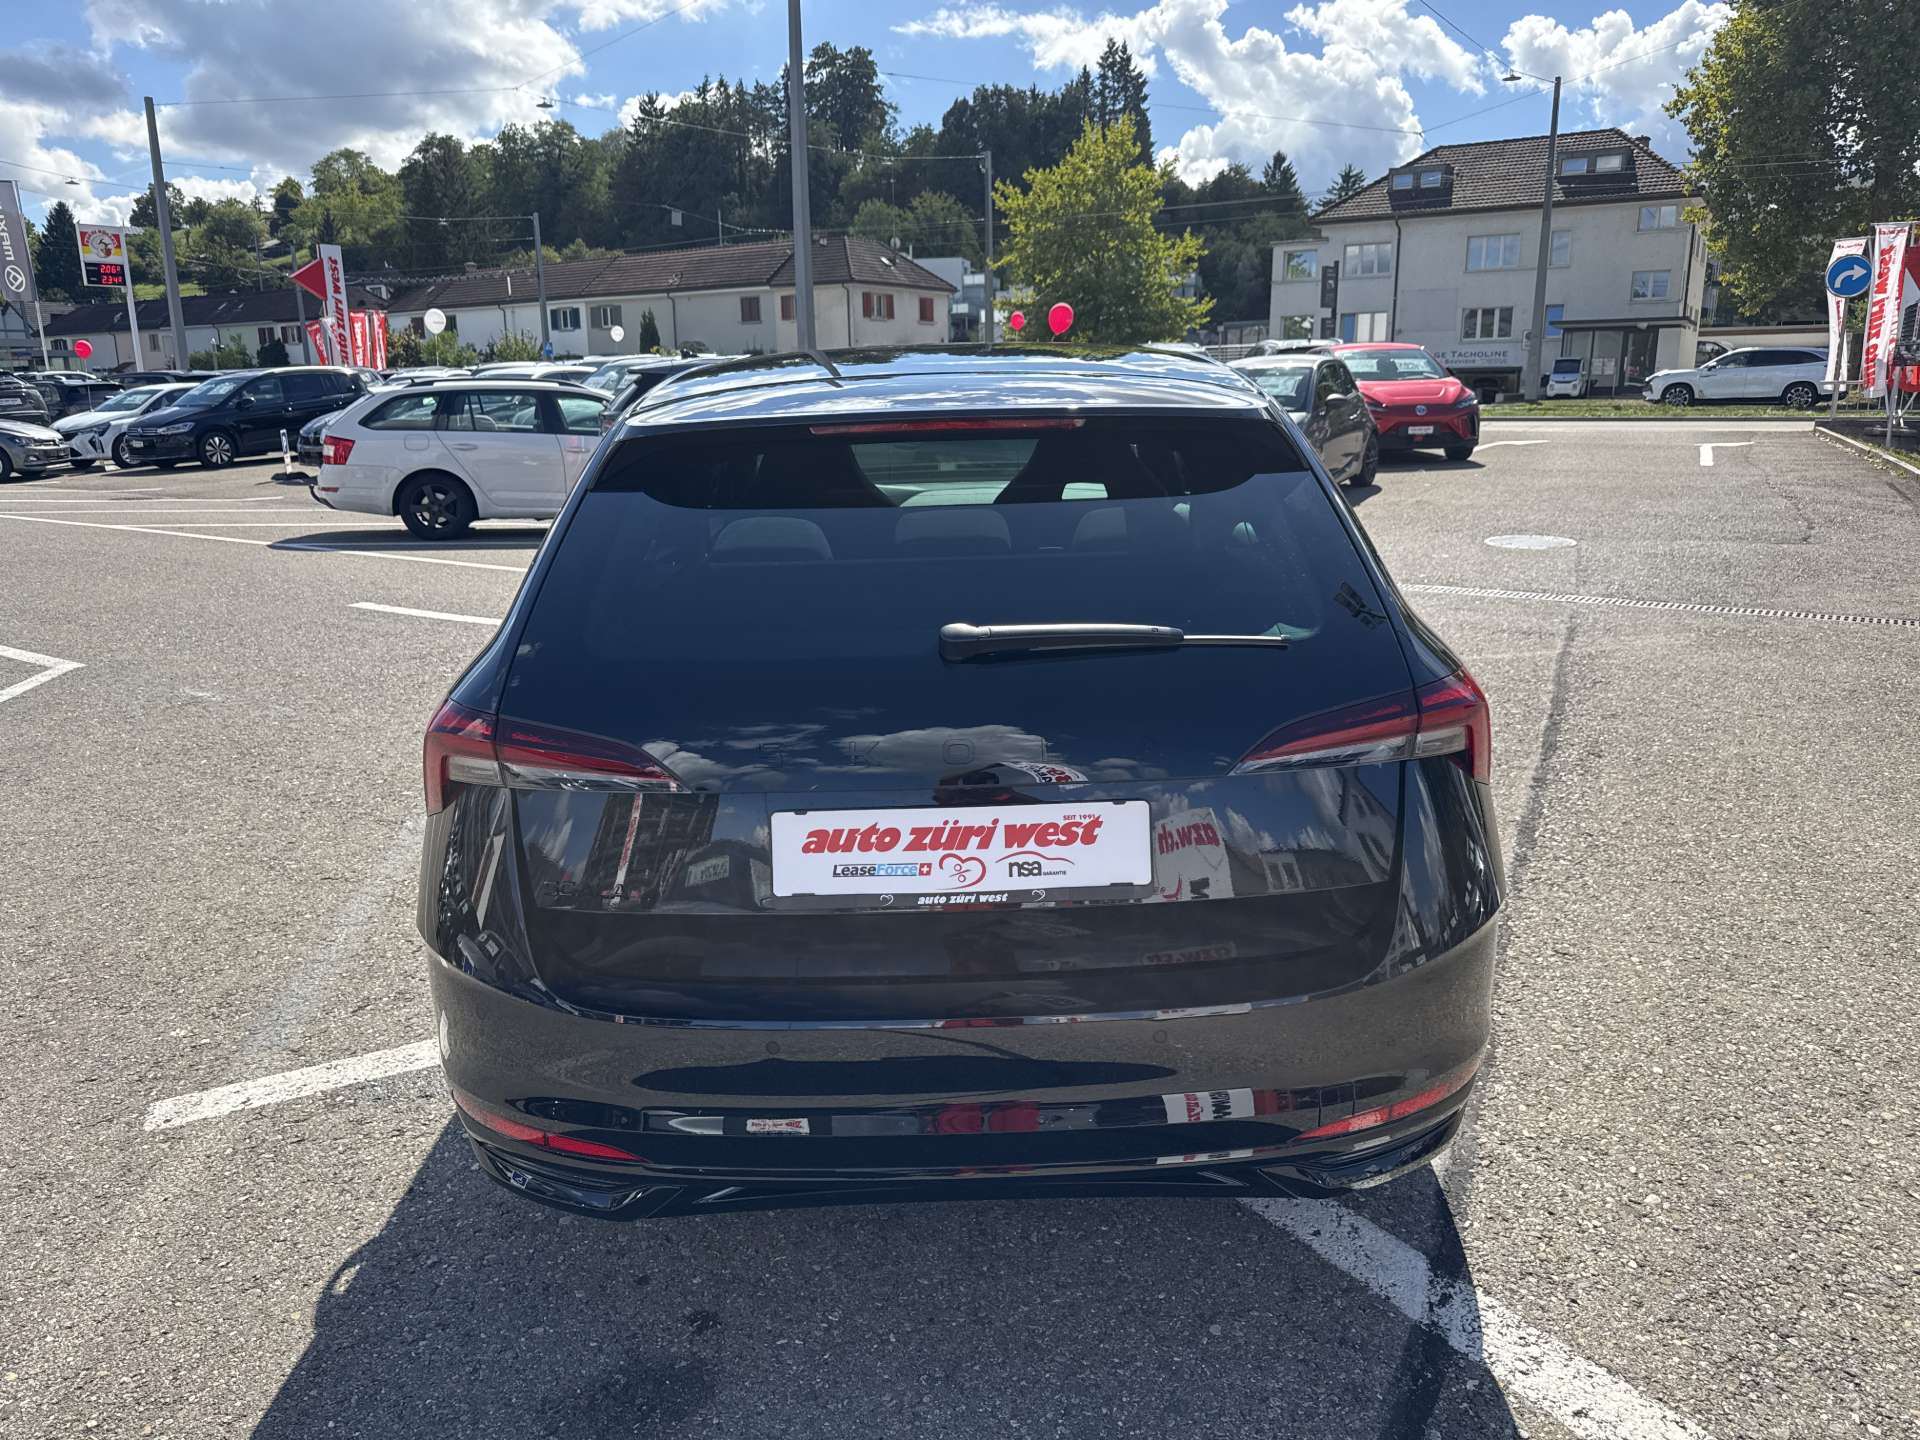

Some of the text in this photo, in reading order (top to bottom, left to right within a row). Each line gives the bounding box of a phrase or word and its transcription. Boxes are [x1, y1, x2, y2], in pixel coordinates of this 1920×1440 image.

[801, 815, 1104, 854] auto züri west
[832, 863, 918, 877] LeaseForce
[1008, 860, 1042, 878] nsa
[917, 892, 1009, 905] auto züri west
